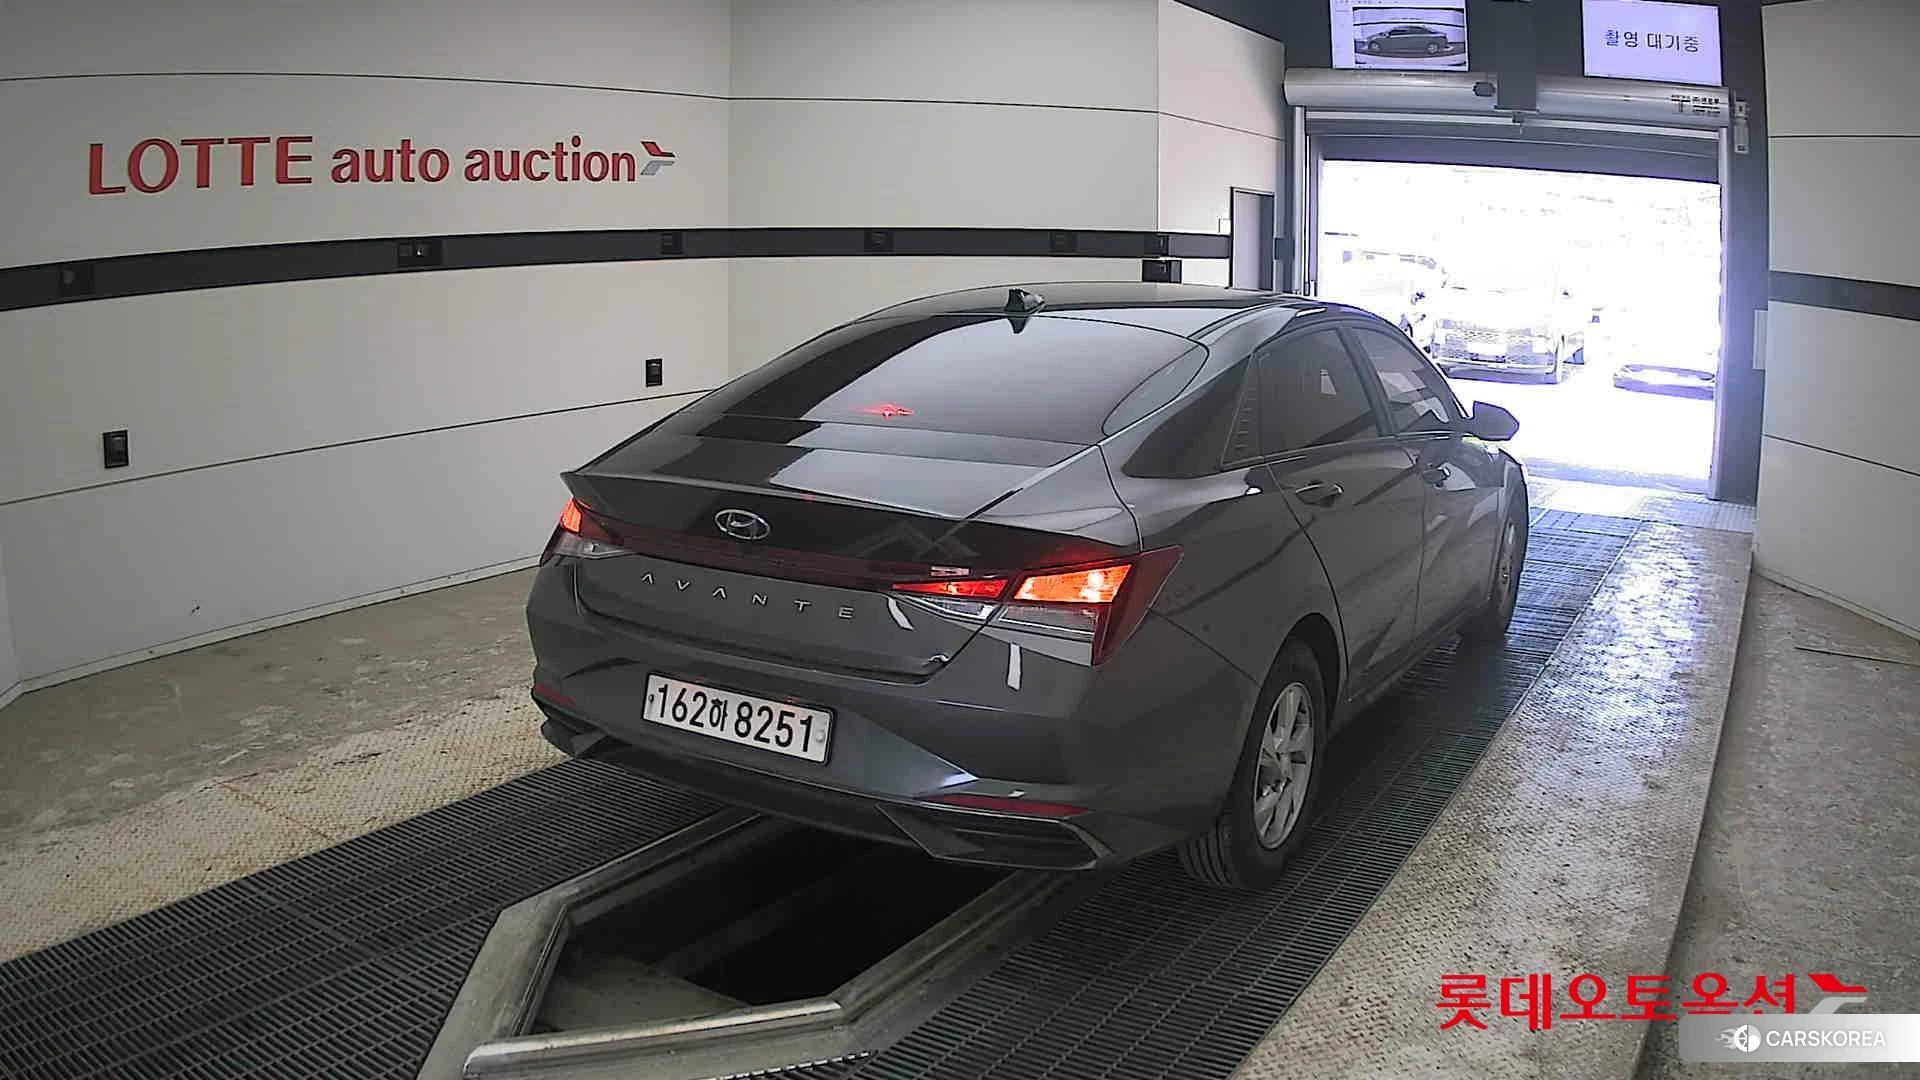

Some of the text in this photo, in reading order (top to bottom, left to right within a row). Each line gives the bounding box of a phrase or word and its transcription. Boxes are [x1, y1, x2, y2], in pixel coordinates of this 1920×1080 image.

[1605, 29, 1699, 53] 촬영 대기중
[88, 135, 637, 195] LOTTE auto auction
[641, 572, 855, 620] AVANTE
[658, 684, 814, 753] 162하 8251
